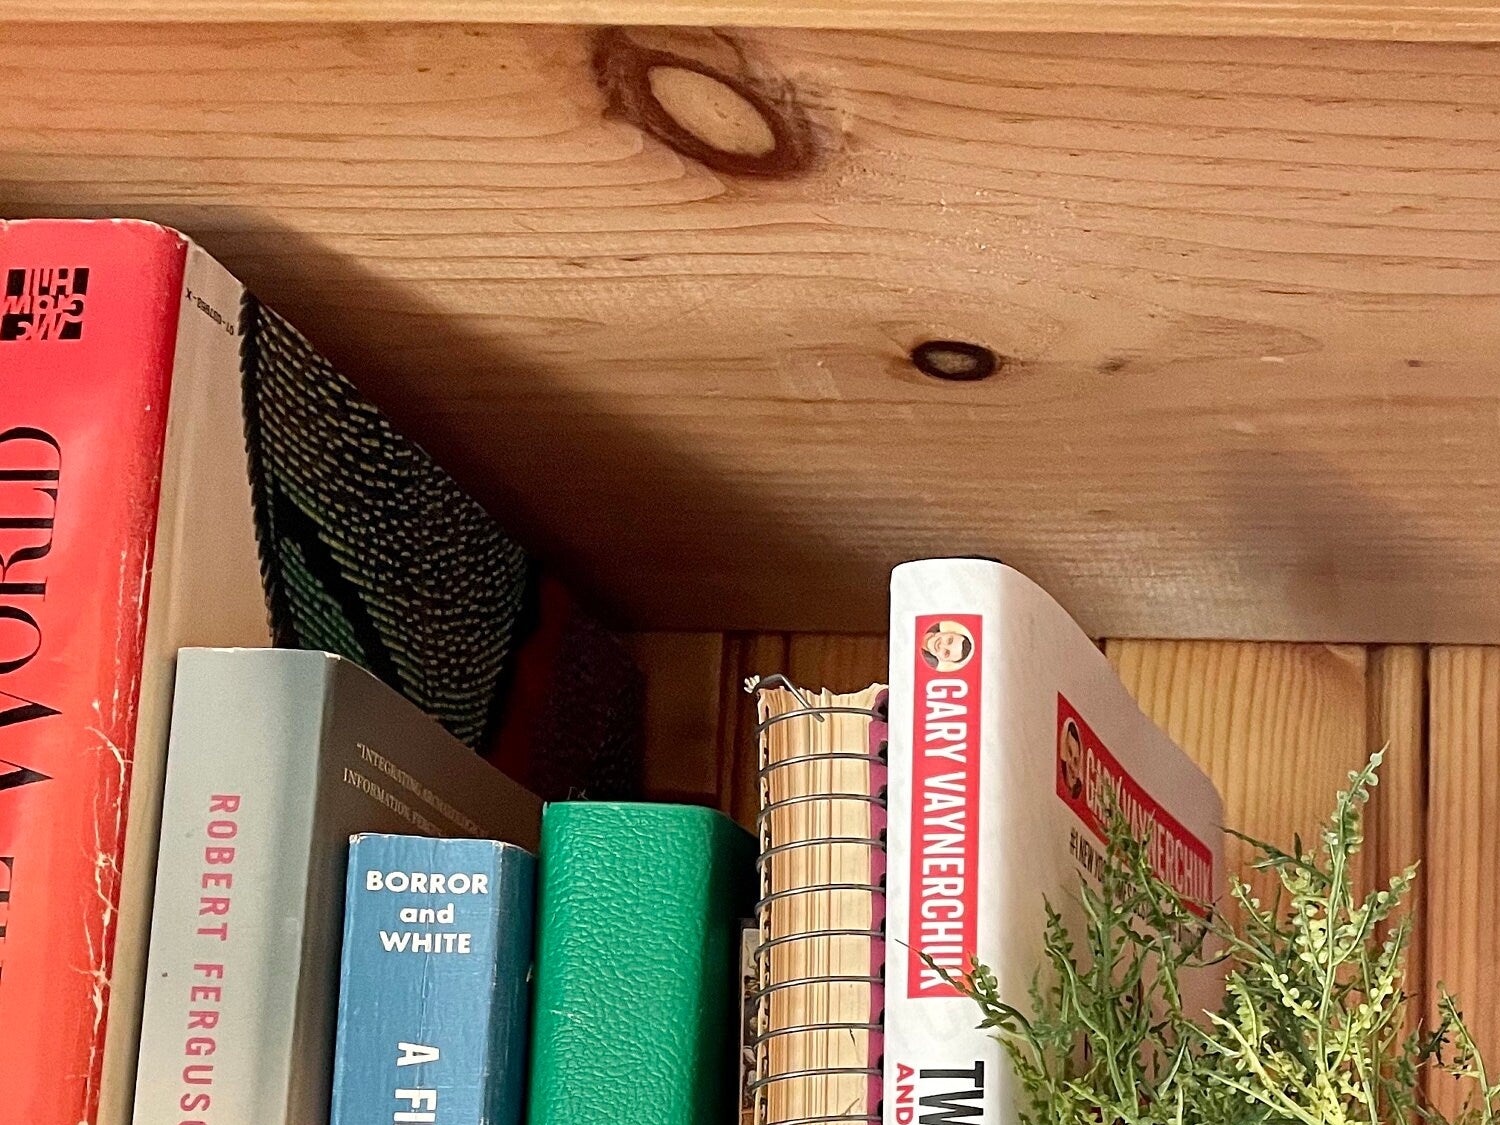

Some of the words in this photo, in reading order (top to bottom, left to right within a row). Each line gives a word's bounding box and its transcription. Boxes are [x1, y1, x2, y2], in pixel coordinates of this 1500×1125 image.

[925, 679, 968, 762] GARY
[197, 795, 240, 941] ROBERT
[366, 870, 489, 896] BORROR
[920, 772, 966, 989] VAYNERCHUK
[399, 902, 456, 926] and
[380, 931, 471, 956] WHITE
[397, 1043, 439, 1066] A
[896, 1063, 914, 1125] AND
